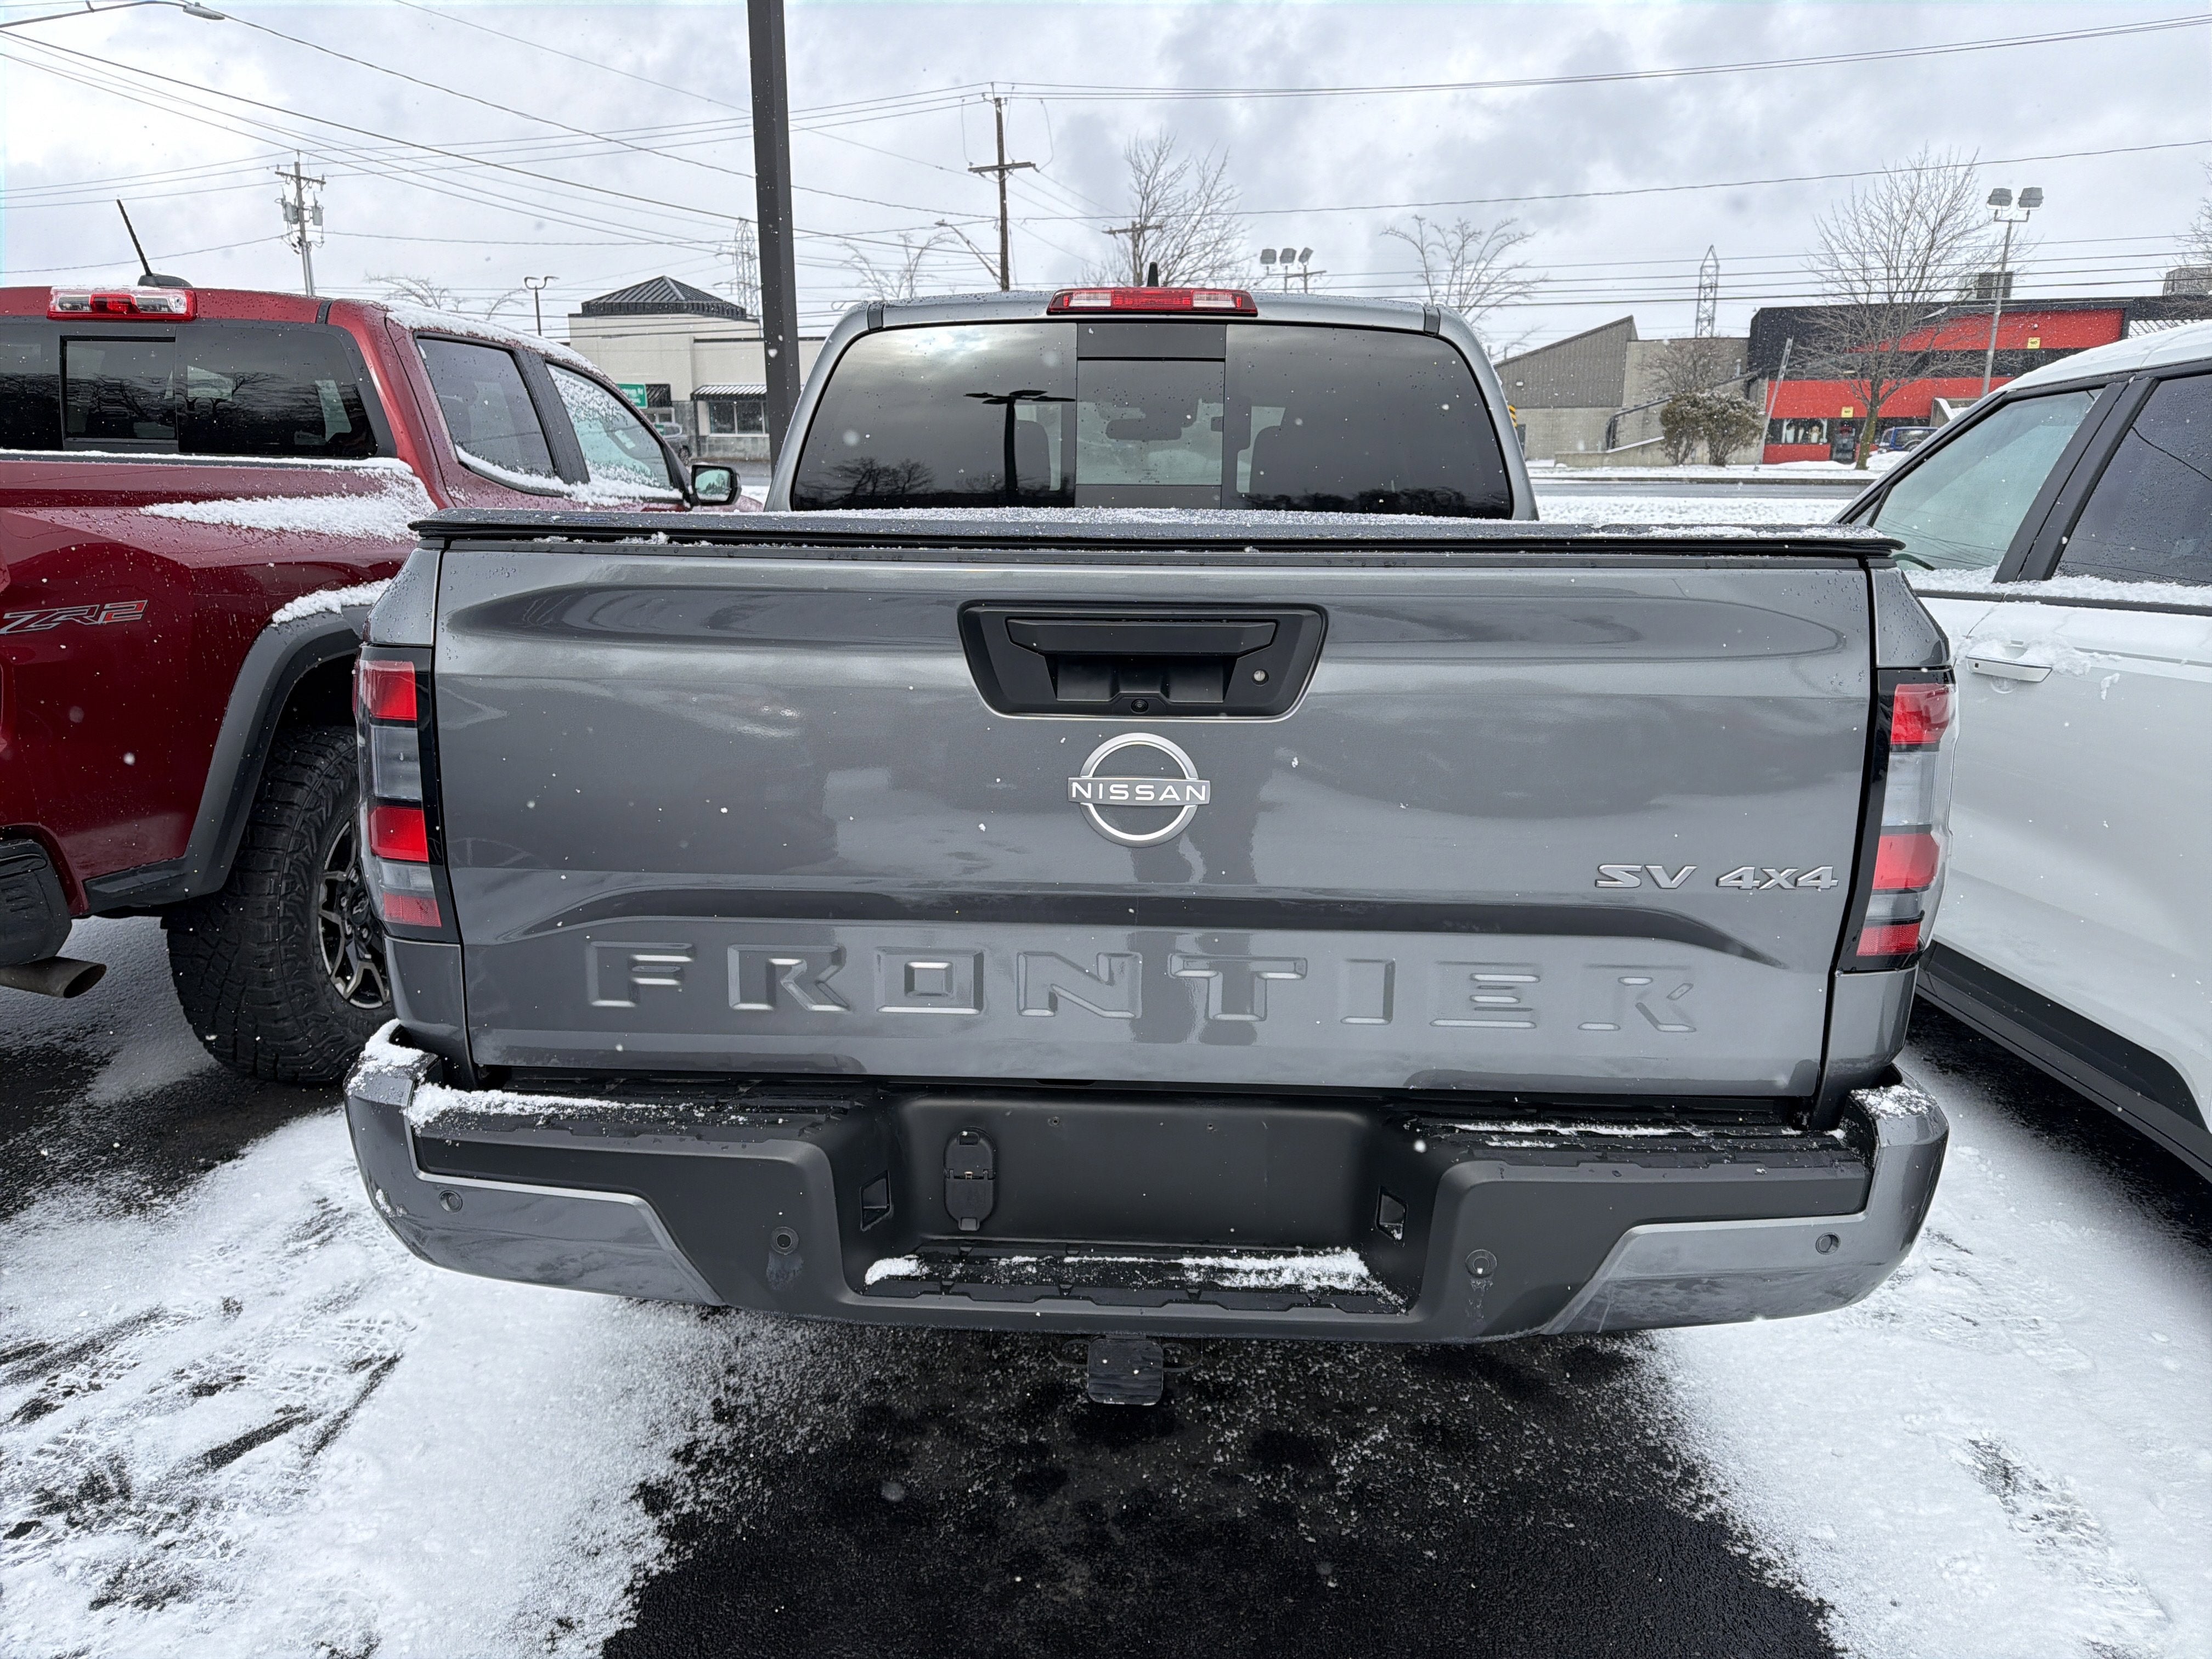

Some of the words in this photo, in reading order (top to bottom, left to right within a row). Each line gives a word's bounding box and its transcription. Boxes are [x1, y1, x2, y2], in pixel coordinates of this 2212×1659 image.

[0, 600, 148, 634] ZR2
[1072, 782, 1206, 801] NISSAN
[1595, 864, 1697, 888] SV
[586, 940, 1697, 1032] FRONTIER
